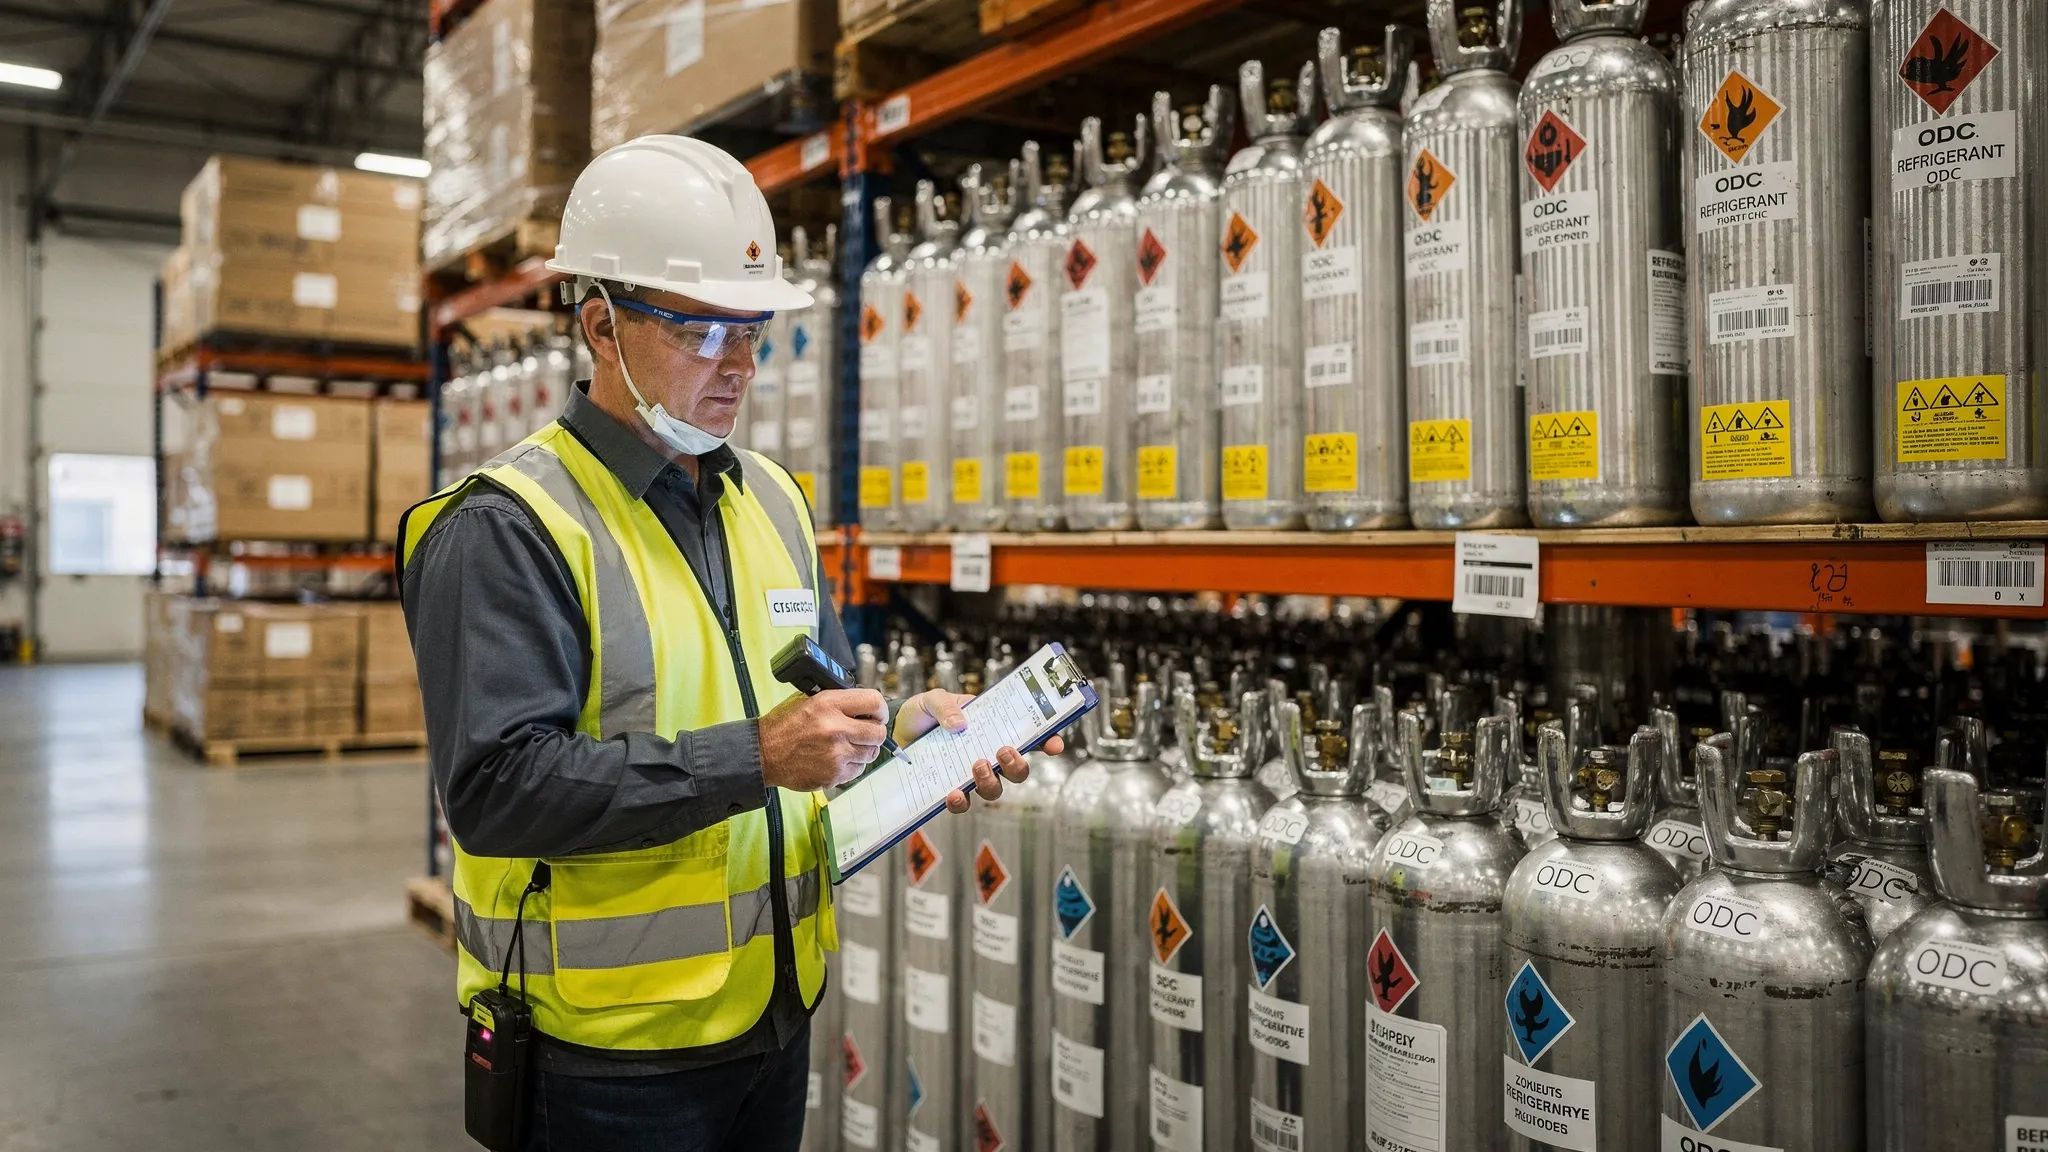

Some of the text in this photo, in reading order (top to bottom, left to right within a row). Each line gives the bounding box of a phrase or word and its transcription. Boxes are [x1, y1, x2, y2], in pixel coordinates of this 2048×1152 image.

[1897, 144, 2006, 173] REFRIGERANT
[1926, 167, 1962, 184] ODC
[1533, 200, 1568, 218] ODC
[1700, 192, 1788, 219] REFRIGERANT
[1264, 815, 1302, 838] ODC
[1389, 838, 1435, 864] ODC
[1653, 827, 1705, 854] ODC
[1537, 865, 1595, 894] ODC
[1694, 901, 1757, 935] ODC
[1917, 949, 1996, 987] ODC
